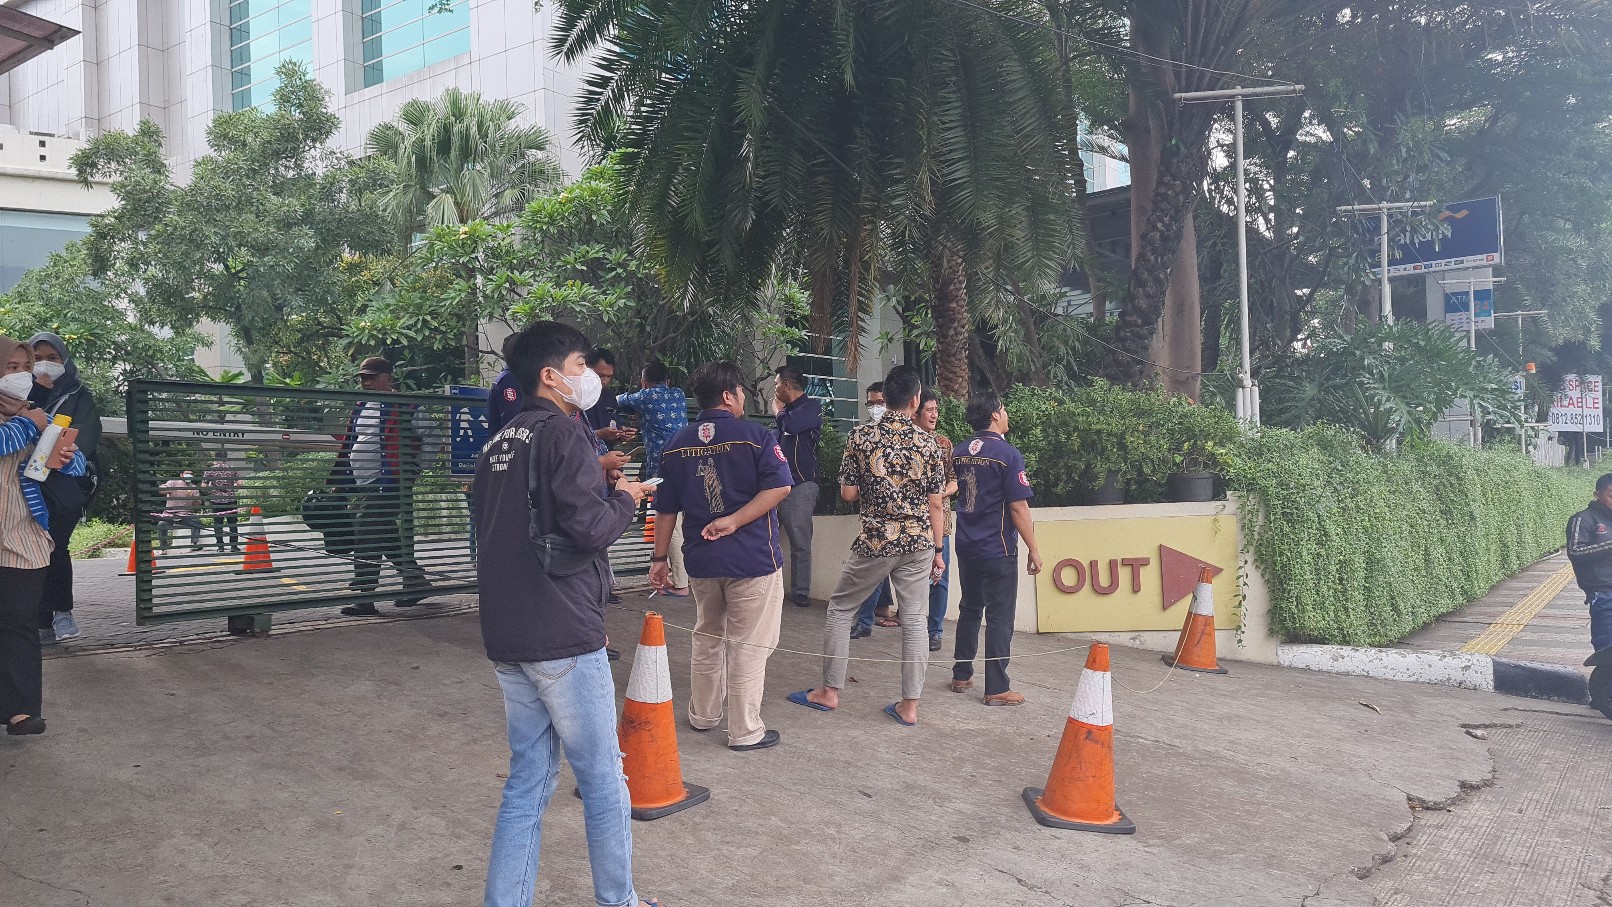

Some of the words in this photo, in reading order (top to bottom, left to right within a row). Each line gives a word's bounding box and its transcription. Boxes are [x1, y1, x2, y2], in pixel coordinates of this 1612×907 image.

[1553, 396, 1599, 409] ILABLE
[681, 444, 730, 457] LITIGATION
[955, 458, 990, 466] LITIGATION
[1053, 557, 1150, 594] OUT
